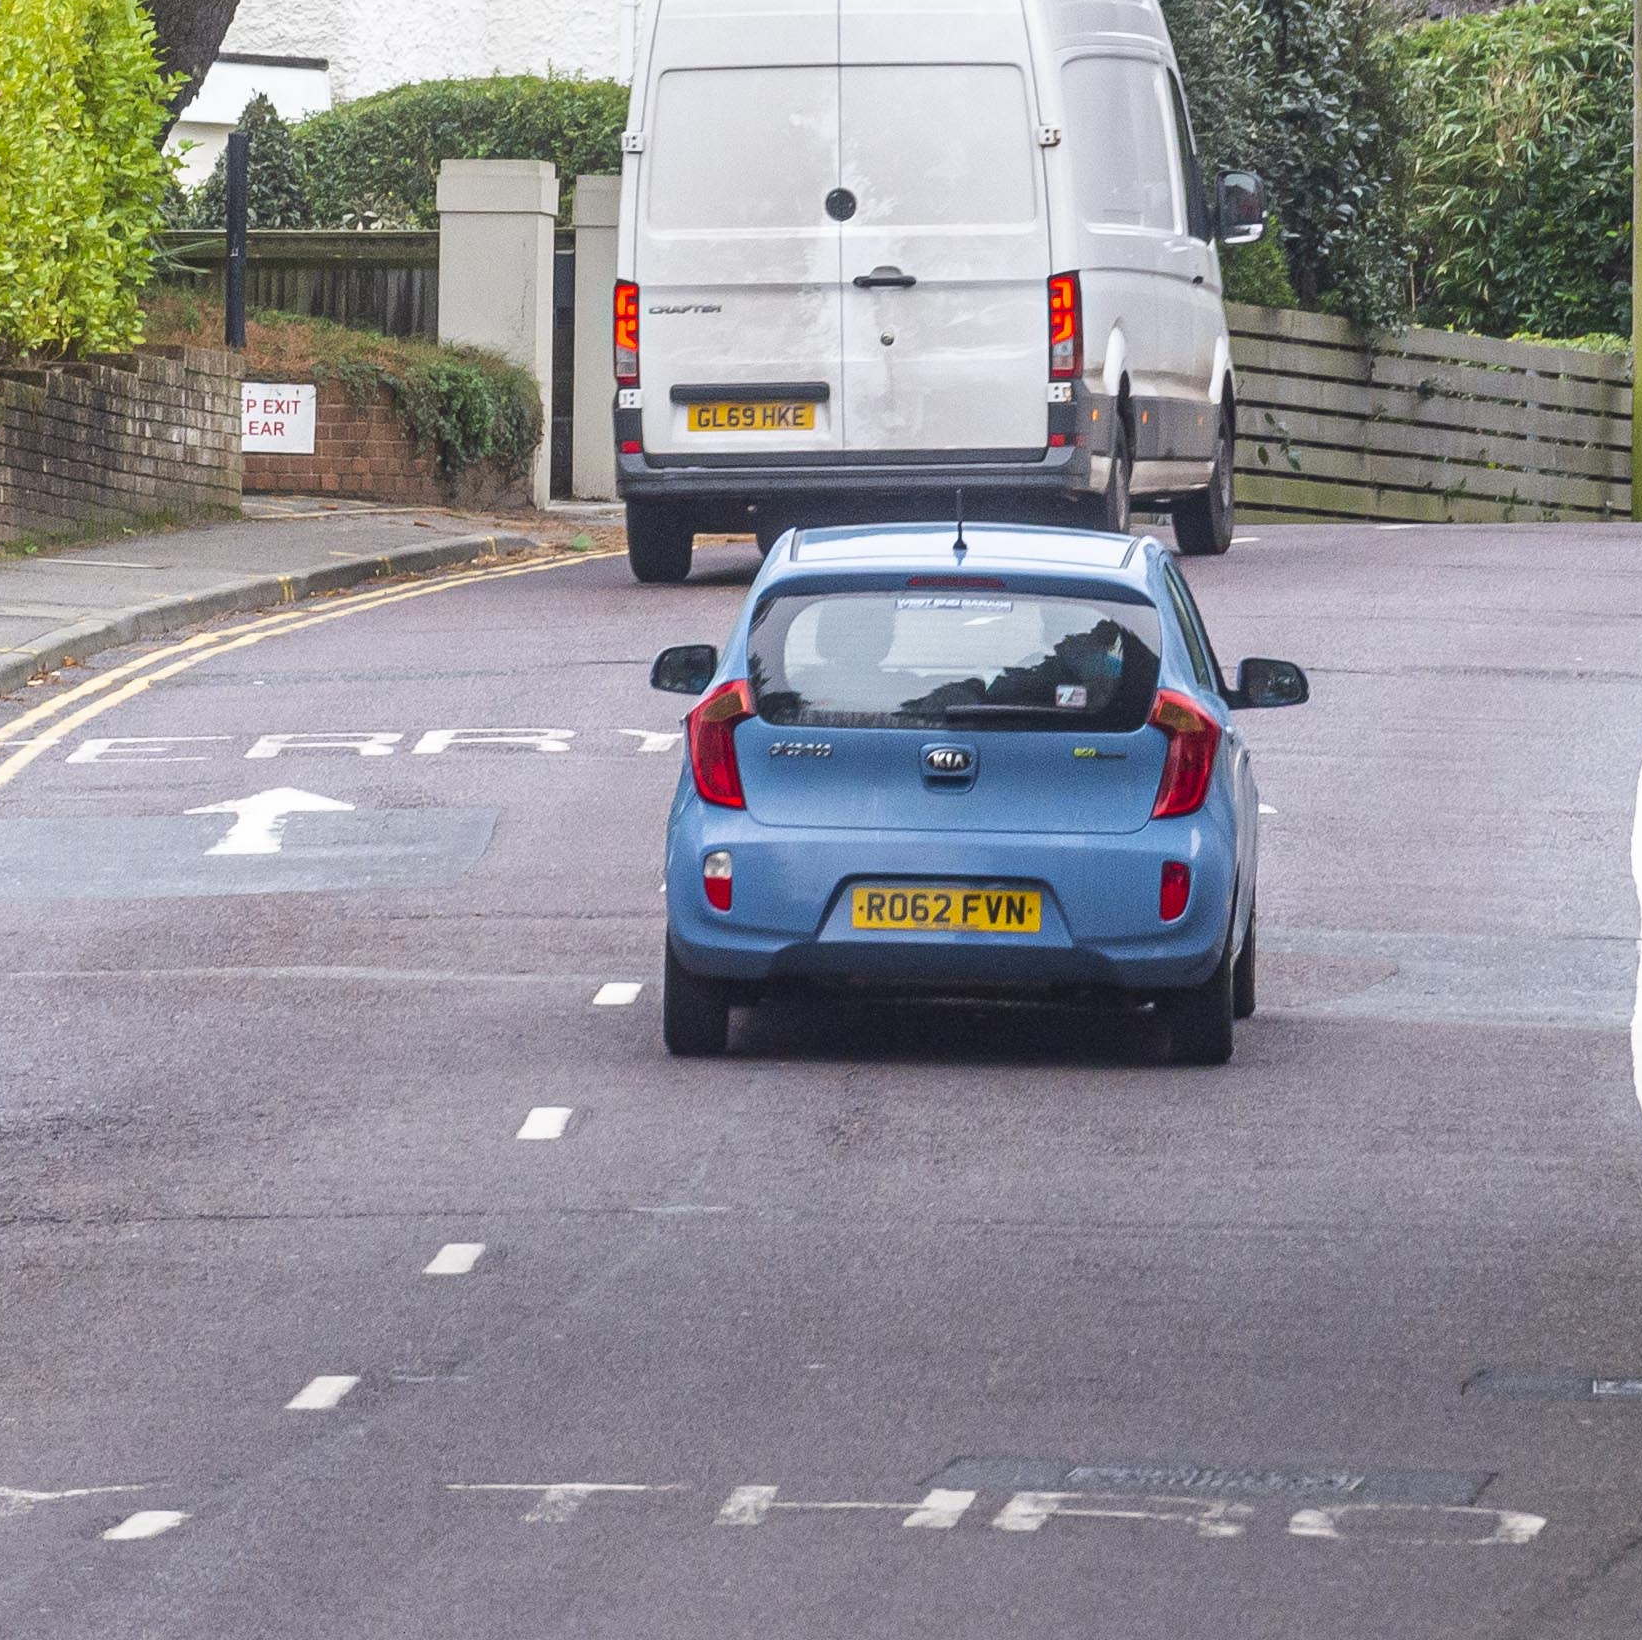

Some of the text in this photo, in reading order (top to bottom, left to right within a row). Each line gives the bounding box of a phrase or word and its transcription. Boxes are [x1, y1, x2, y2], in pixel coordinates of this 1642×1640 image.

[241, 399, 301, 415] P EXIT
[697, 406, 805, 428] GL69 HKE
[933, 752, 965, 769] KIA
[867, 892, 1026, 924] RO62 FVN
